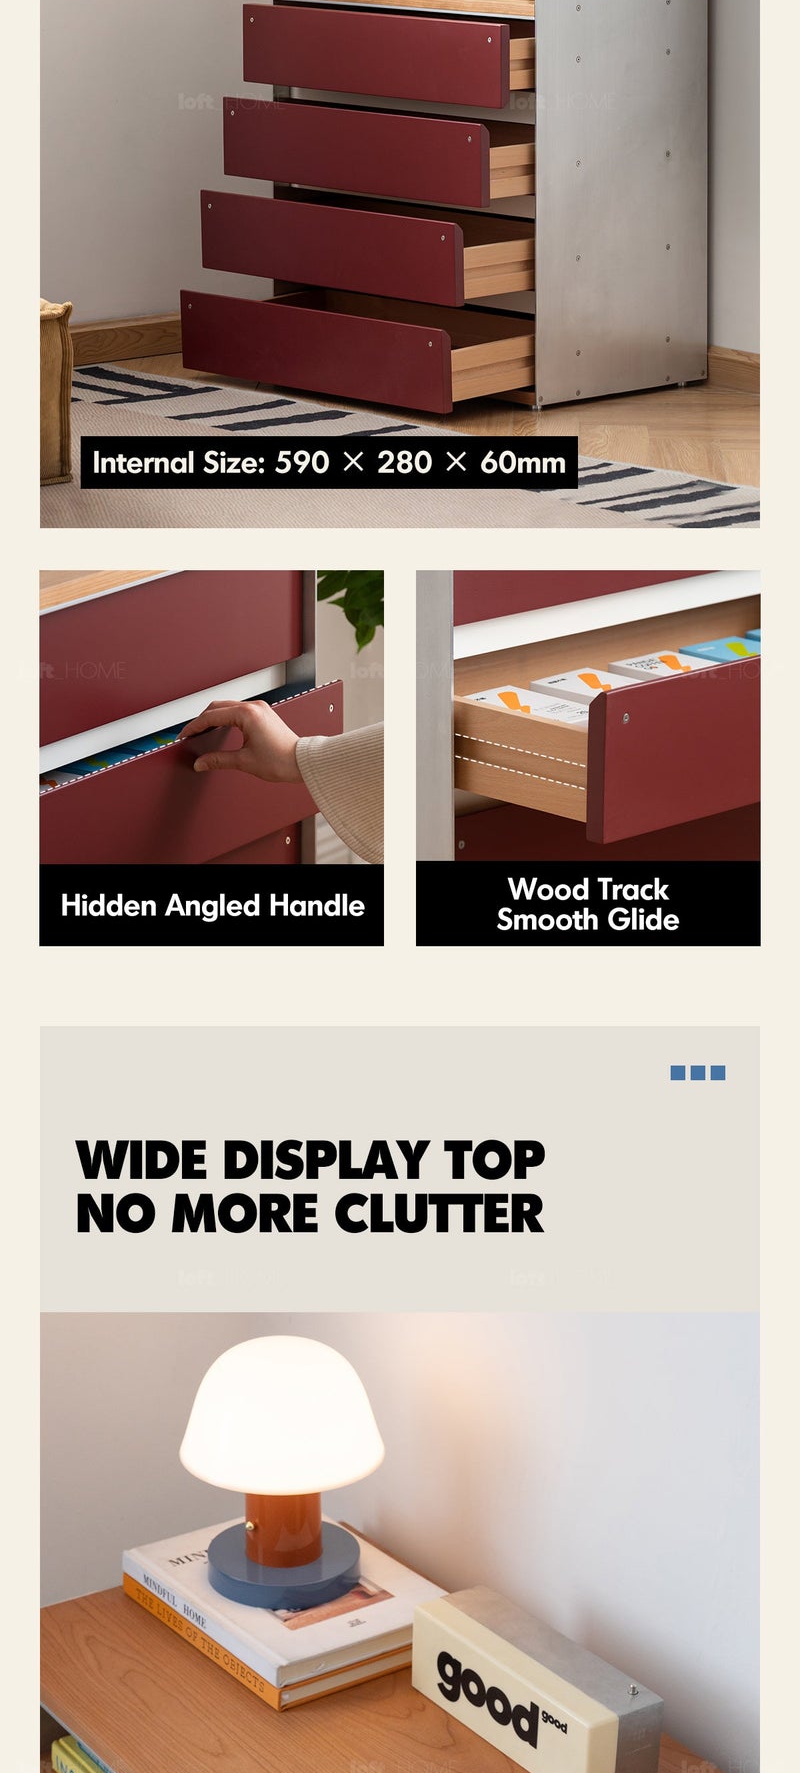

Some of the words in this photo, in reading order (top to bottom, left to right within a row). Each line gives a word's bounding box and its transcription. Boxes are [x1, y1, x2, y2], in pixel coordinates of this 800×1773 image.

[144, 1574, 177, 1608] MINDFUL
[183, 1603, 207, 1629] HOME
[136, 1588, 154, 1609] THE
[157, 1602, 183, 1628] LIVES
[186, 1626, 198, 1642] OF
[200, 1637, 220, 1659] THE
[223, 1655, 265, 1693] OBJECTS
[437, 1651, 539, 1749] good
[542, 1710, 568, 1734] good
